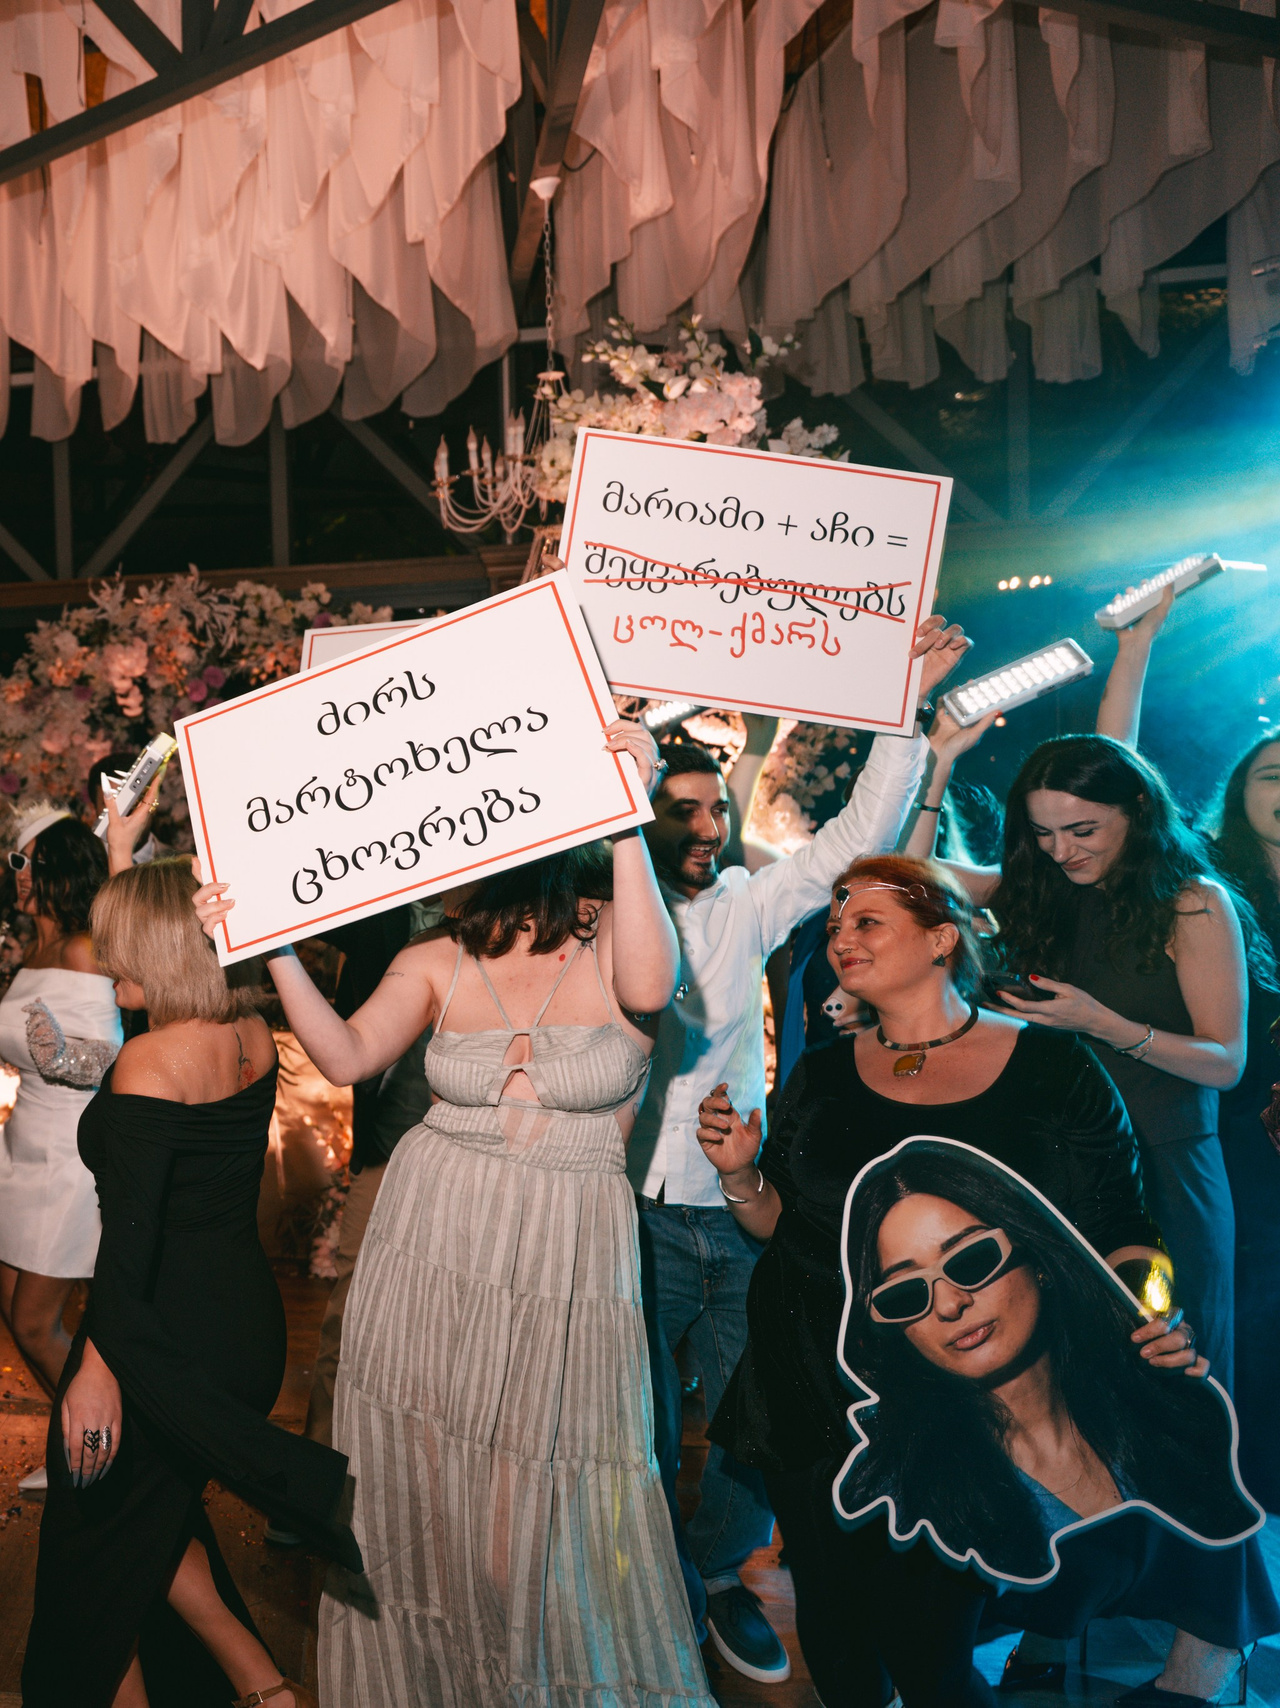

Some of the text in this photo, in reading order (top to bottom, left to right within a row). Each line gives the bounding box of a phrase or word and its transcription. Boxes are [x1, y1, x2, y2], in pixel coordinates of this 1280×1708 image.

[602, 480, 765, 532] მარიამი
[777, 514, 798, 536] +
[810, 511, 875, 548] აჩი
[585, 544, 906, 622] შეყვარებულებს
[613, 611, 841, 659] ცოლ-ქმარს
[317, 670, 436, 736] ძირს
[246, 706, 549, 833] მარტოხელა
[292, 787, 541, 905] ცხოვრება
